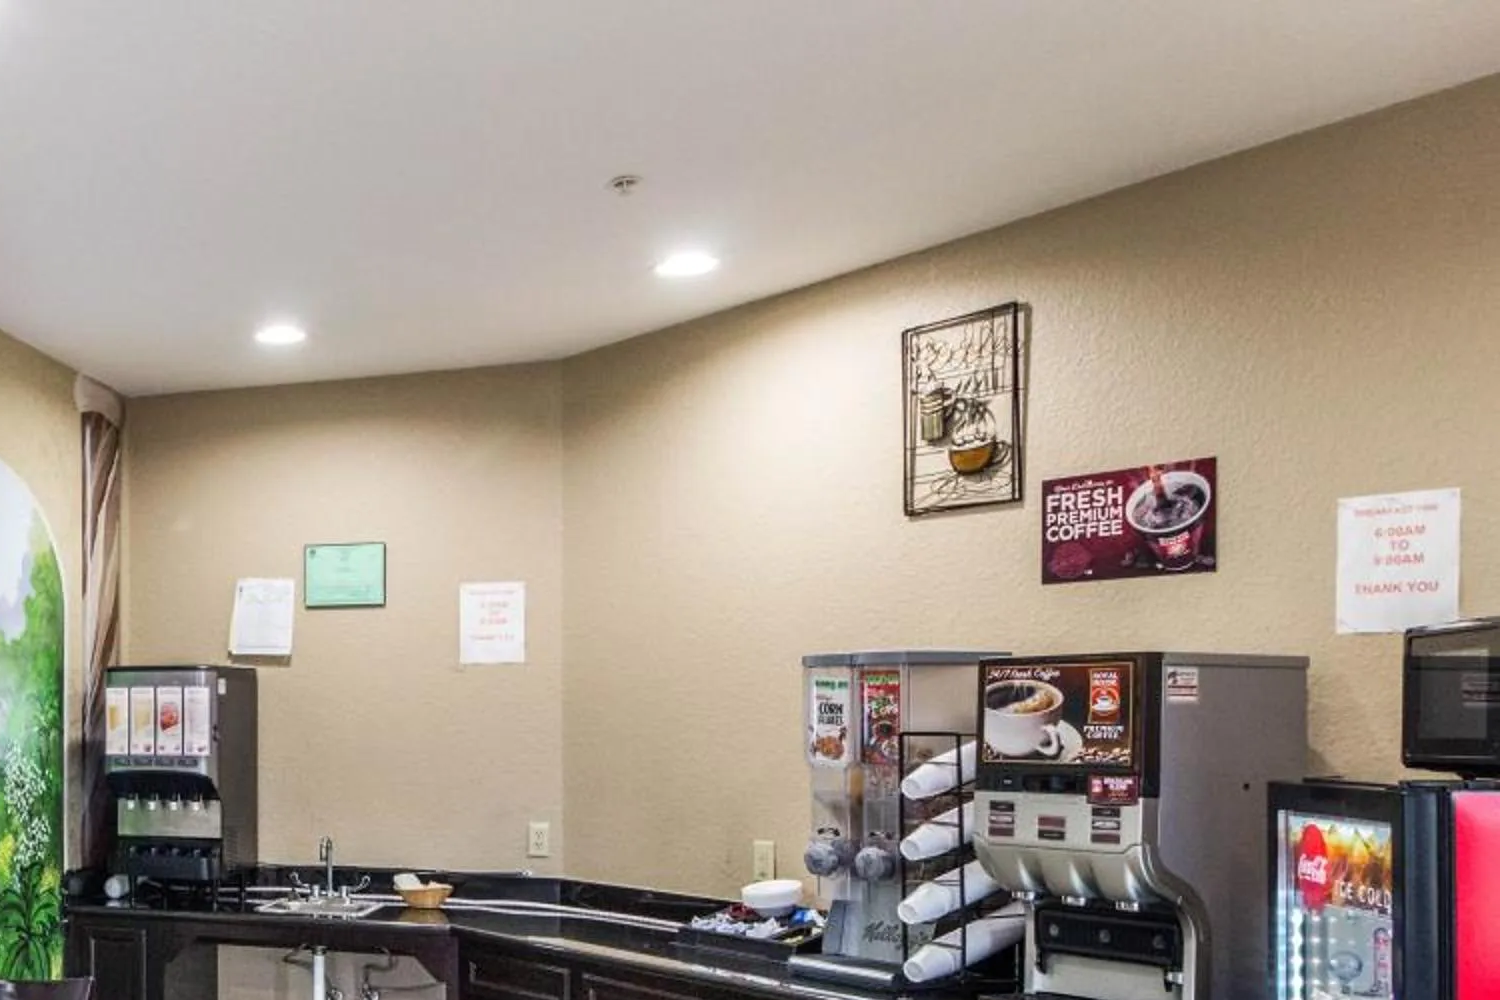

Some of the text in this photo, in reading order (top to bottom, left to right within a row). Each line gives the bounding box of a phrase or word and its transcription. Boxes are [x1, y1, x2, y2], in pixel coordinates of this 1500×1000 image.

[1046, 486, 1124, 513] FRESH
[1046, 506, 1123, 527] PREMIUM
[1046, 520, 1123, 543] COFFEE
[1390, 539, 1410, 552] TO
[1355, 580, 1439, 596] THANK YOU
[818, 703, 844, 715] CORN
